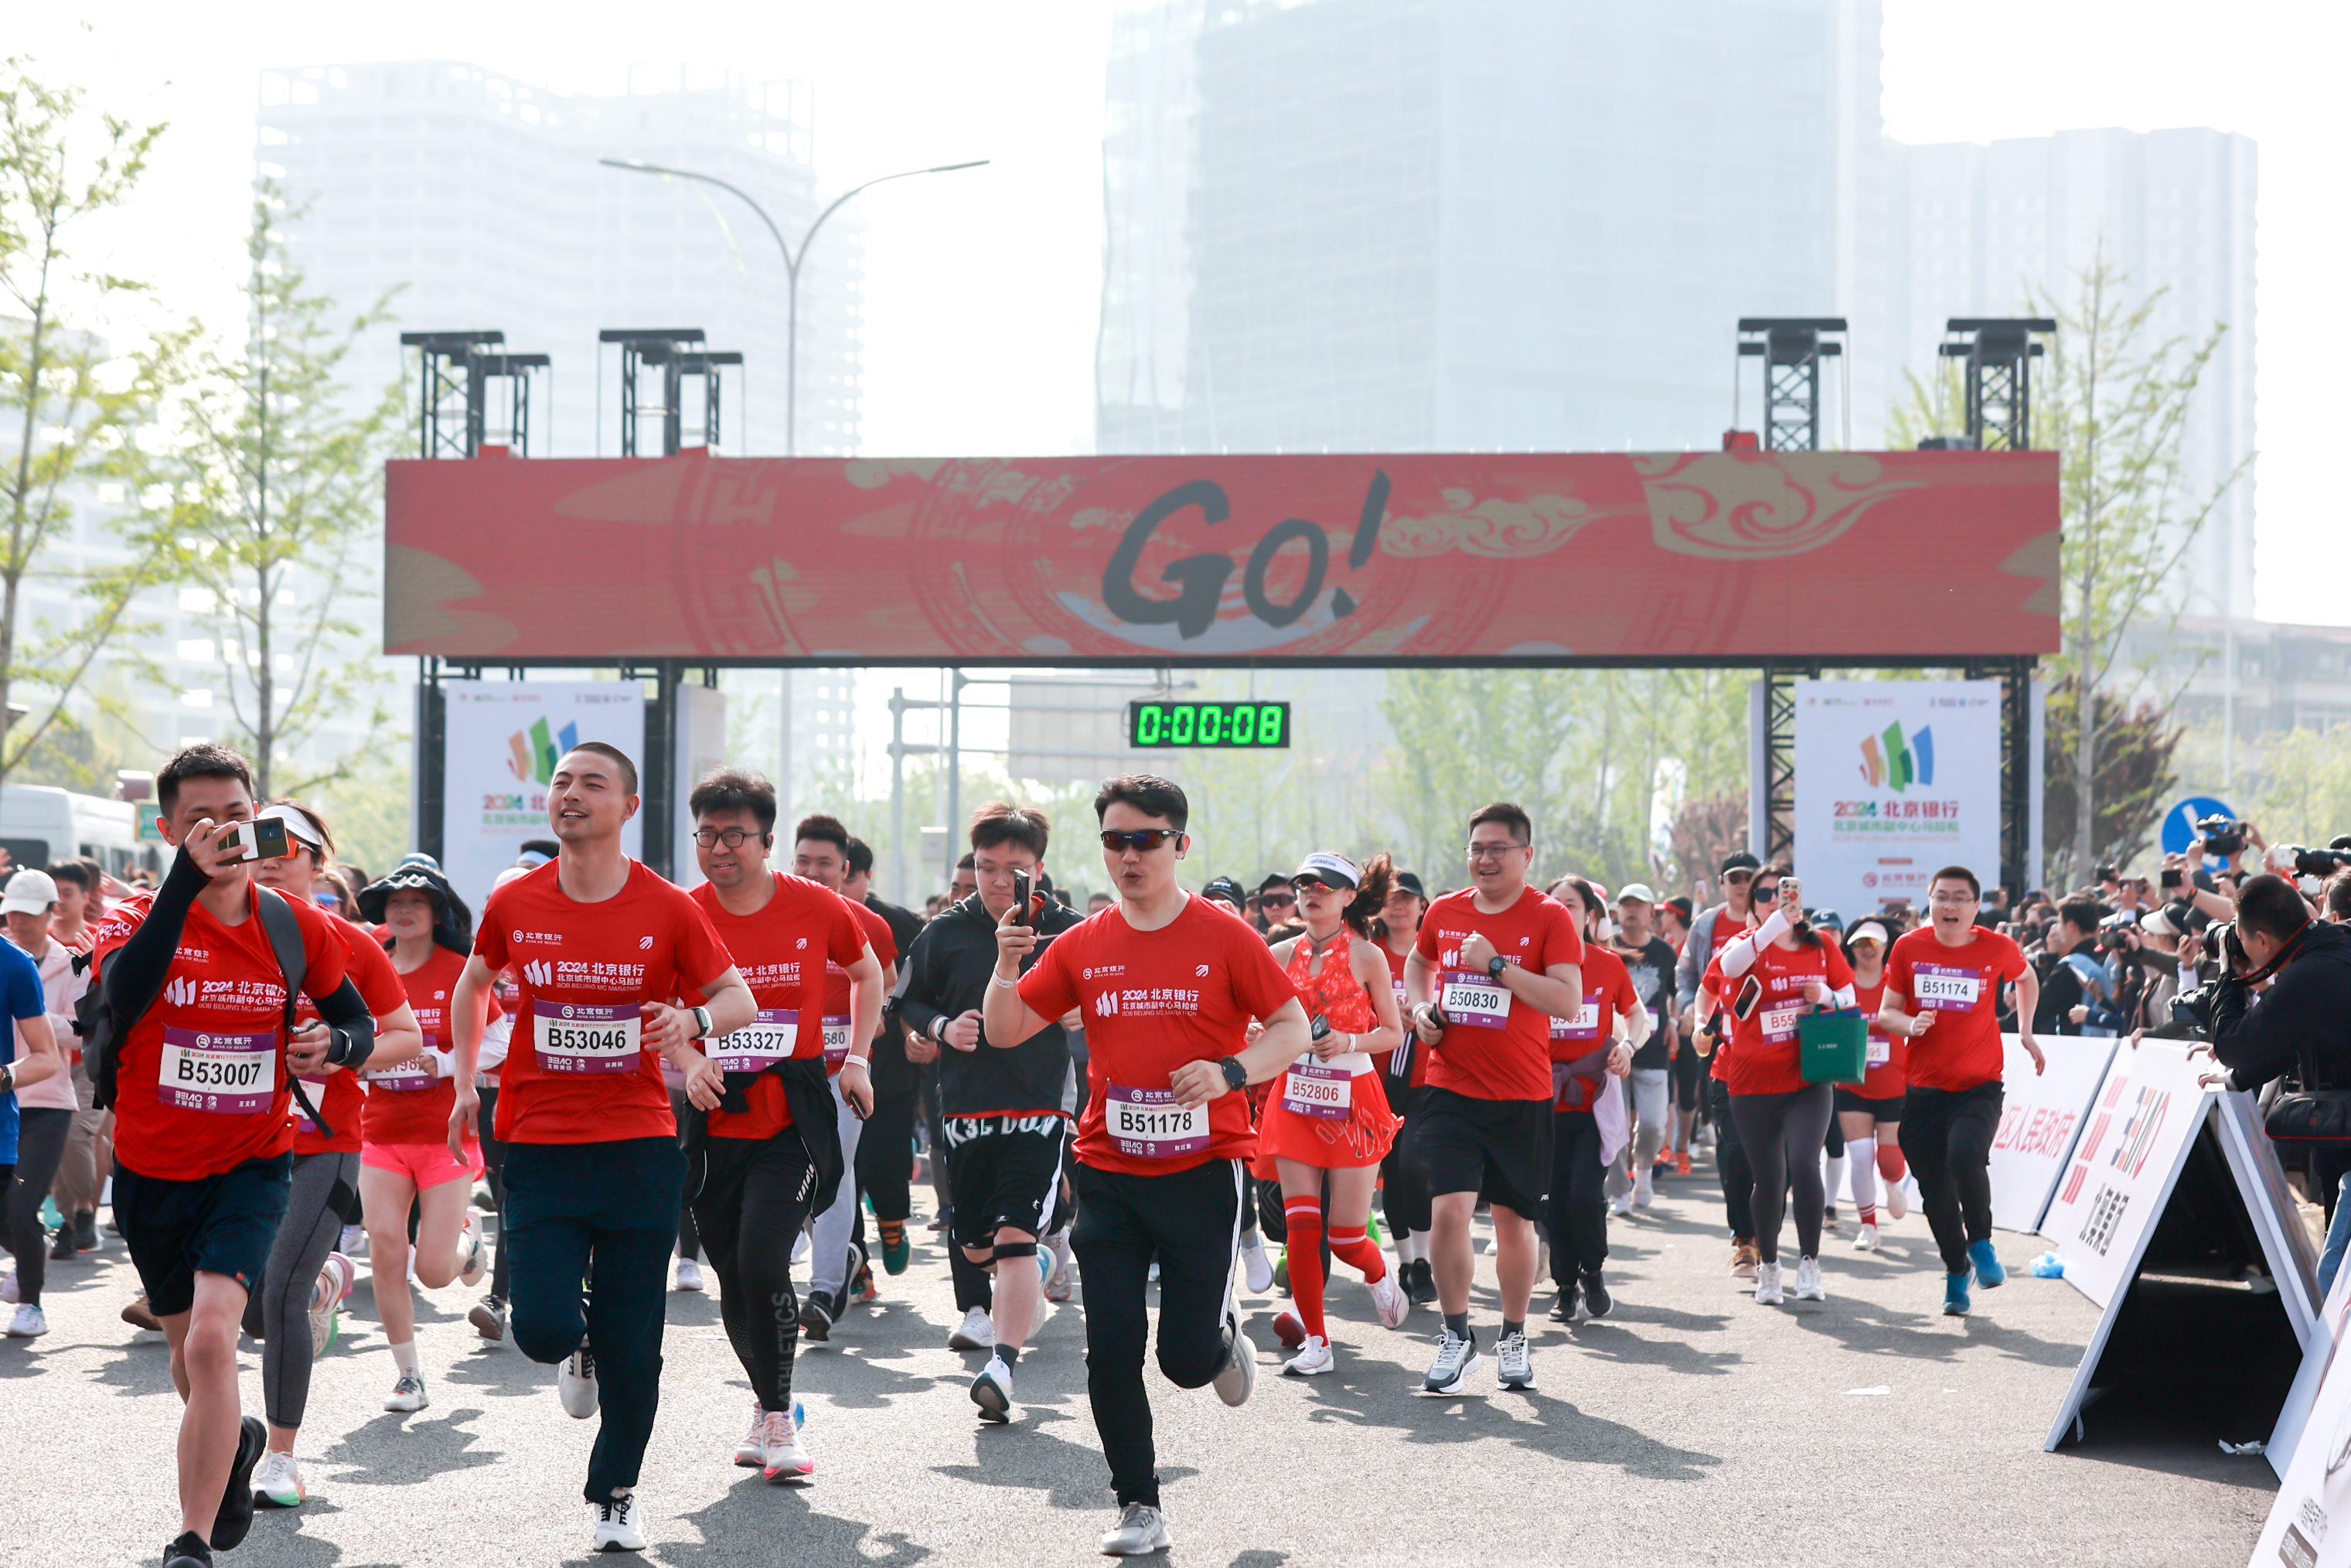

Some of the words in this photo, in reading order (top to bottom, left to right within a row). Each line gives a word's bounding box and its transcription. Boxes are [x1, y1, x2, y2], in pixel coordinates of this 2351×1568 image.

[1137, 705, 1283, 744] 0:00:08
[483, 794, 523, 810] 2024
[1834, 801, 1878, 817] 2024
[1883, 801, 1960, 818] 北京银行
[525, 932, 563, 941] 北京银行
[557, 960, 589, 974] 2024
[591, 963, 645, 977] 北京银行
[756, 962, 800, 976] 北京银行
[1094, 965, 1126, 973] 北京银行
[557, 973, 643, 985] 北京城市副中心马拉松
[202, 980, 233, 994] 2024
[1923, 981, 1968, 996] B51174
[1122, 990, 1148, 1000] 2024
[1150, 988, 1199, 1002] 北京银行
[1450, 991, 1498, 1009] B50830
[213, 1003, 240, 1011] BEIJING
[1122, 1001, 1198, 1011] 北京城市副中心马拉松
[548, 1028, 626, 1049] B53046
[718, 1031, 784, 1050] B53327
[547, 1056, 572, 1065] BEIAO
[178, 1058, 261, 1086] B53007
[175, 1090, 203, 1103] BEIAO
[1293, 1081, 1338, 1101] B52806
[1120, 1112, 1192, 1133] B51178
[1120, 1140, 1143, 1149] BEIAO
[772, 1292, 798, 1404] ATHLETICS
